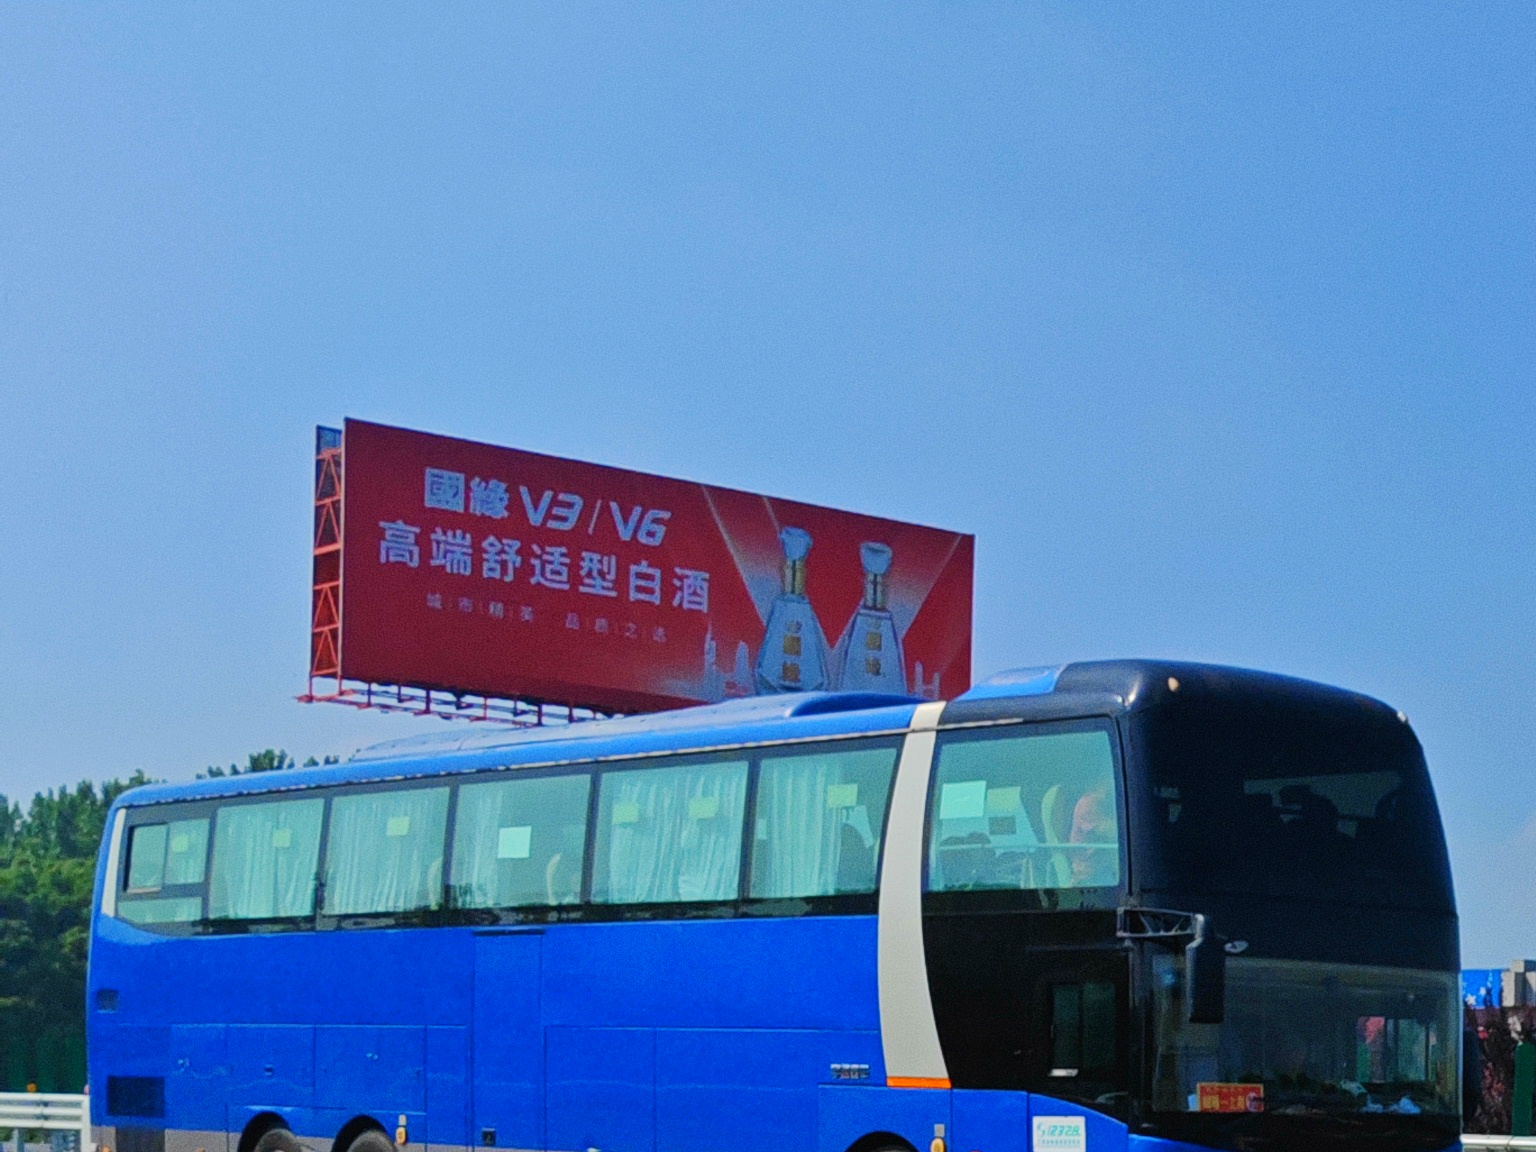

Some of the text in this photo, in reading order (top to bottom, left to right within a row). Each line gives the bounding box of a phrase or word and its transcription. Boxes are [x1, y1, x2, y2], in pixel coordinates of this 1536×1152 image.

[379, 520, 710, 614] 高端舒适型白酒
